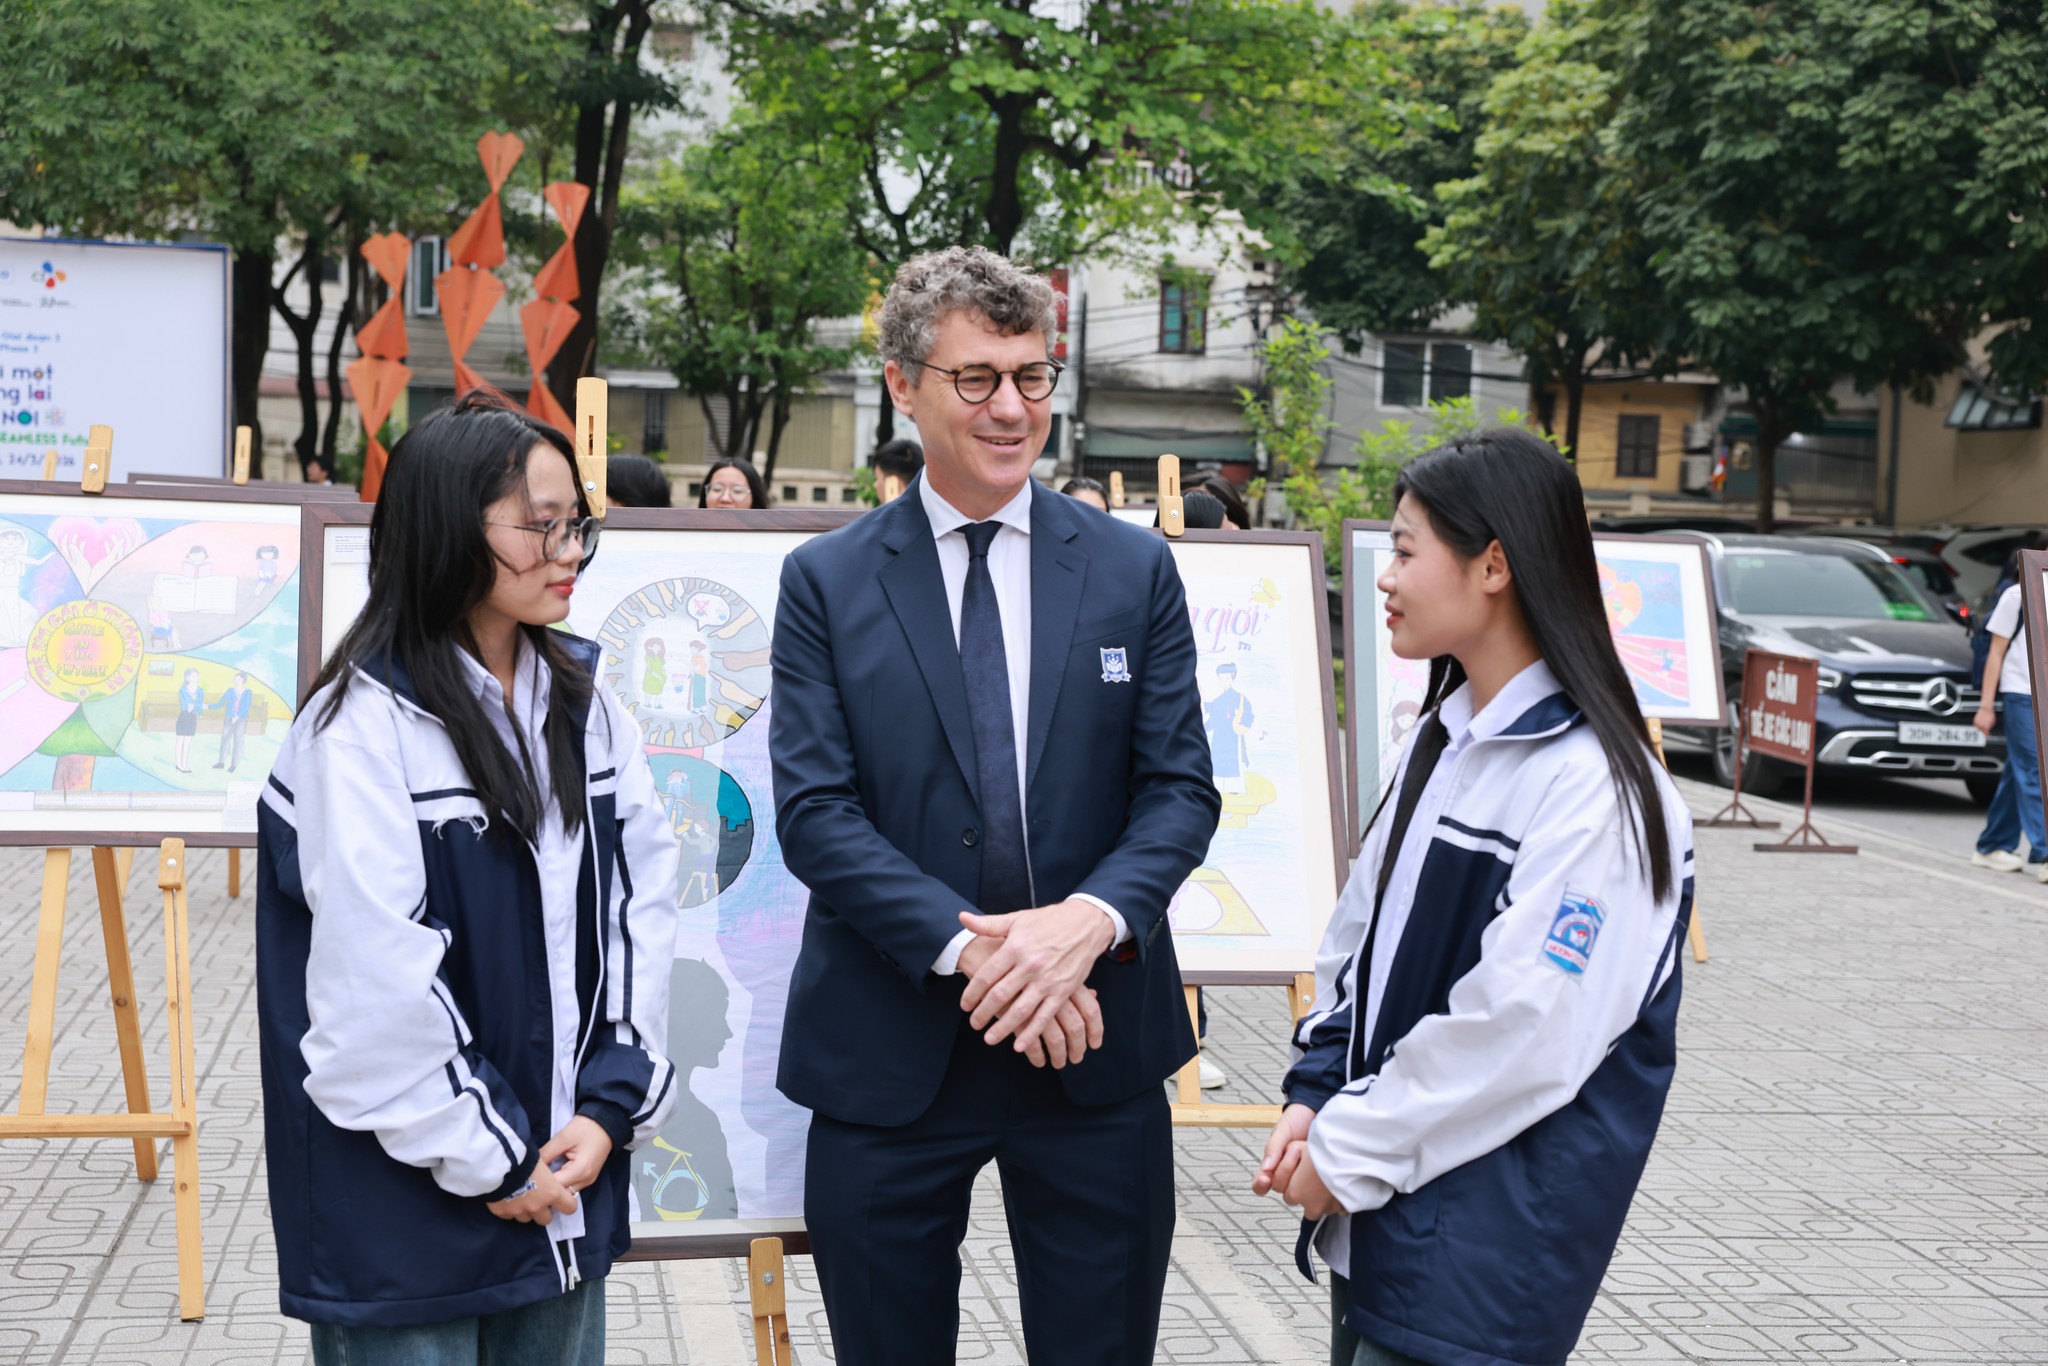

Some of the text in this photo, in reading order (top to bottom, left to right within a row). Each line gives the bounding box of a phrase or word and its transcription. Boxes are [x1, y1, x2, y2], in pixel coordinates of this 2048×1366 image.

[64, 622, 105, 637] GIRLS
[73, 639, 89, 650] IN
[57, 664, 108, 678] FUTURE
[1766, 660, 1798, 705] CẤM
